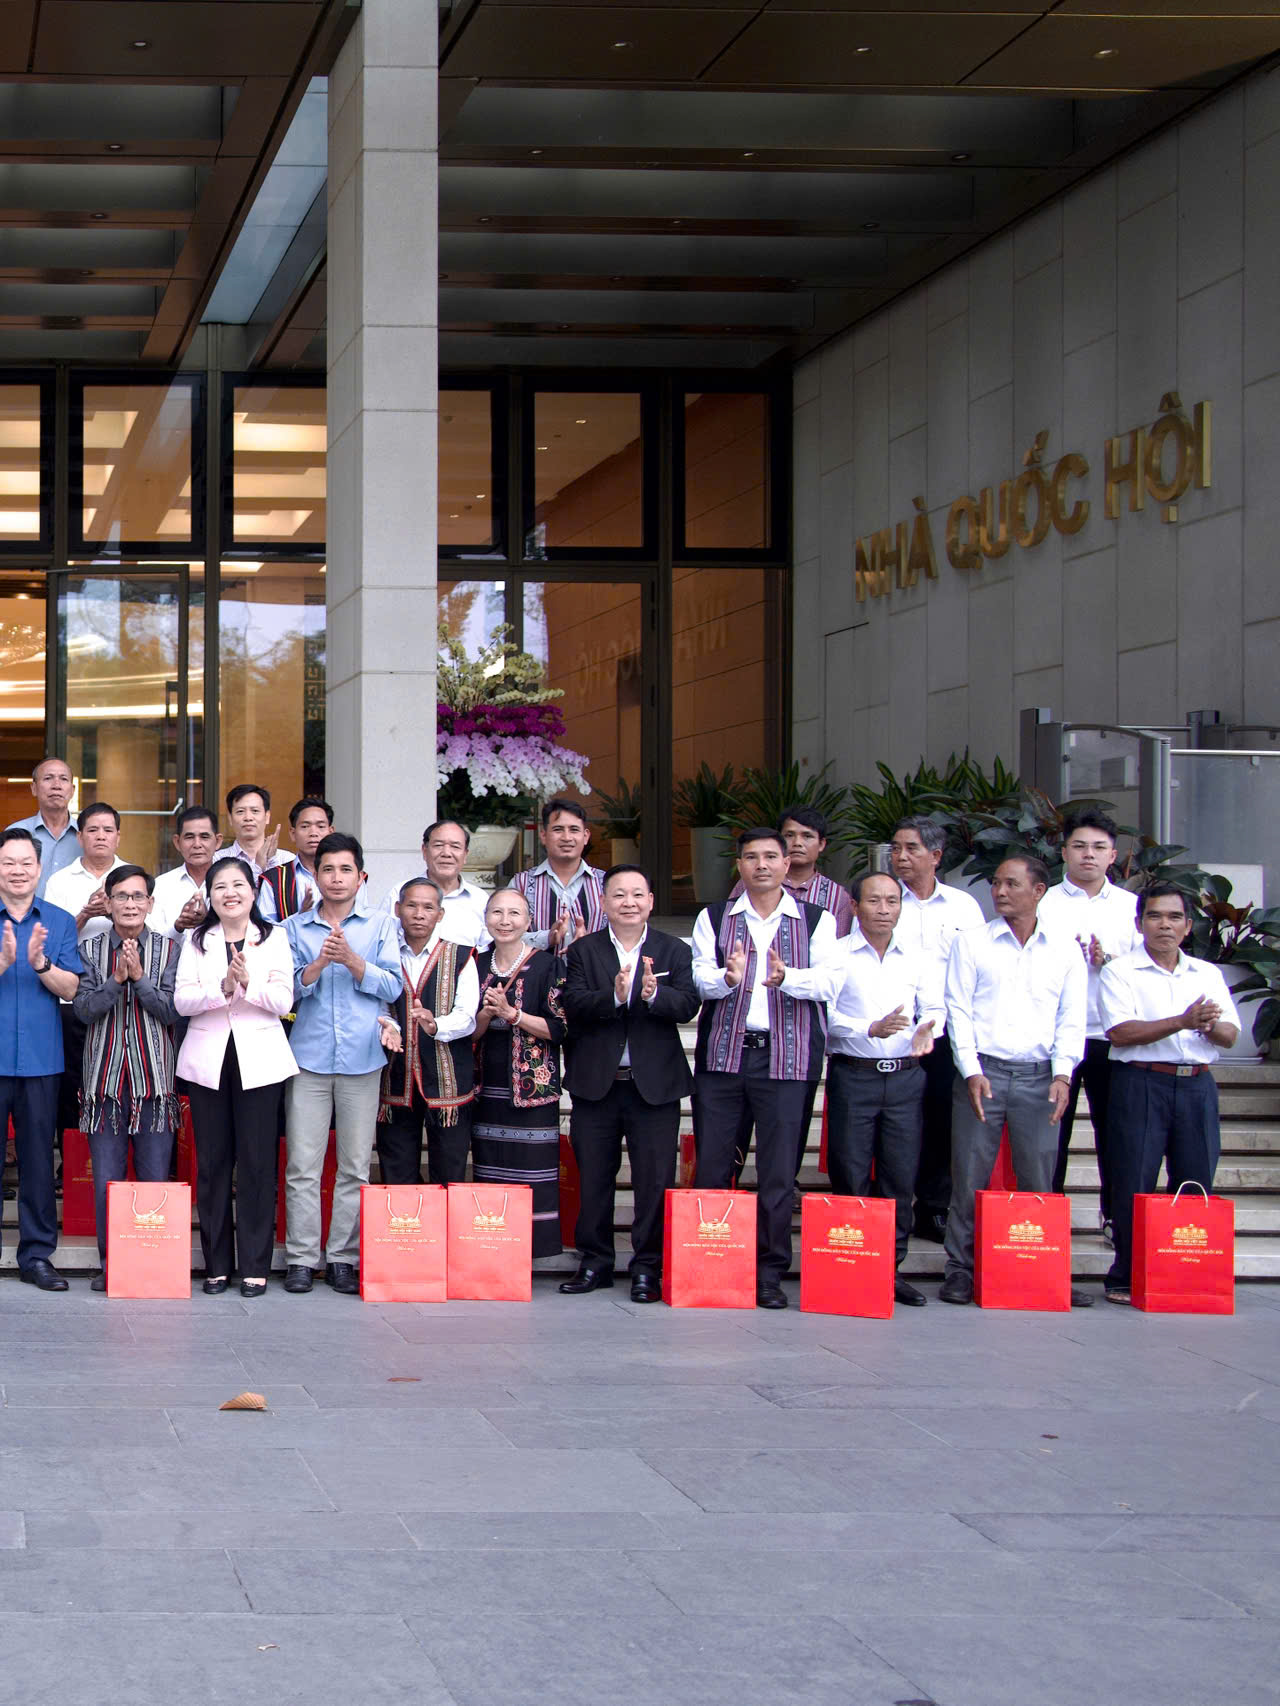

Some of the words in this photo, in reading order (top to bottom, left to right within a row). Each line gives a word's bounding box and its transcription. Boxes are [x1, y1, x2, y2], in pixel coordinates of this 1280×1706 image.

[855, 496, 938, 603] NHÀ
[946, 429, 1090, 570] QUỐC
[1104, 391, 1212, 523] HỘI
